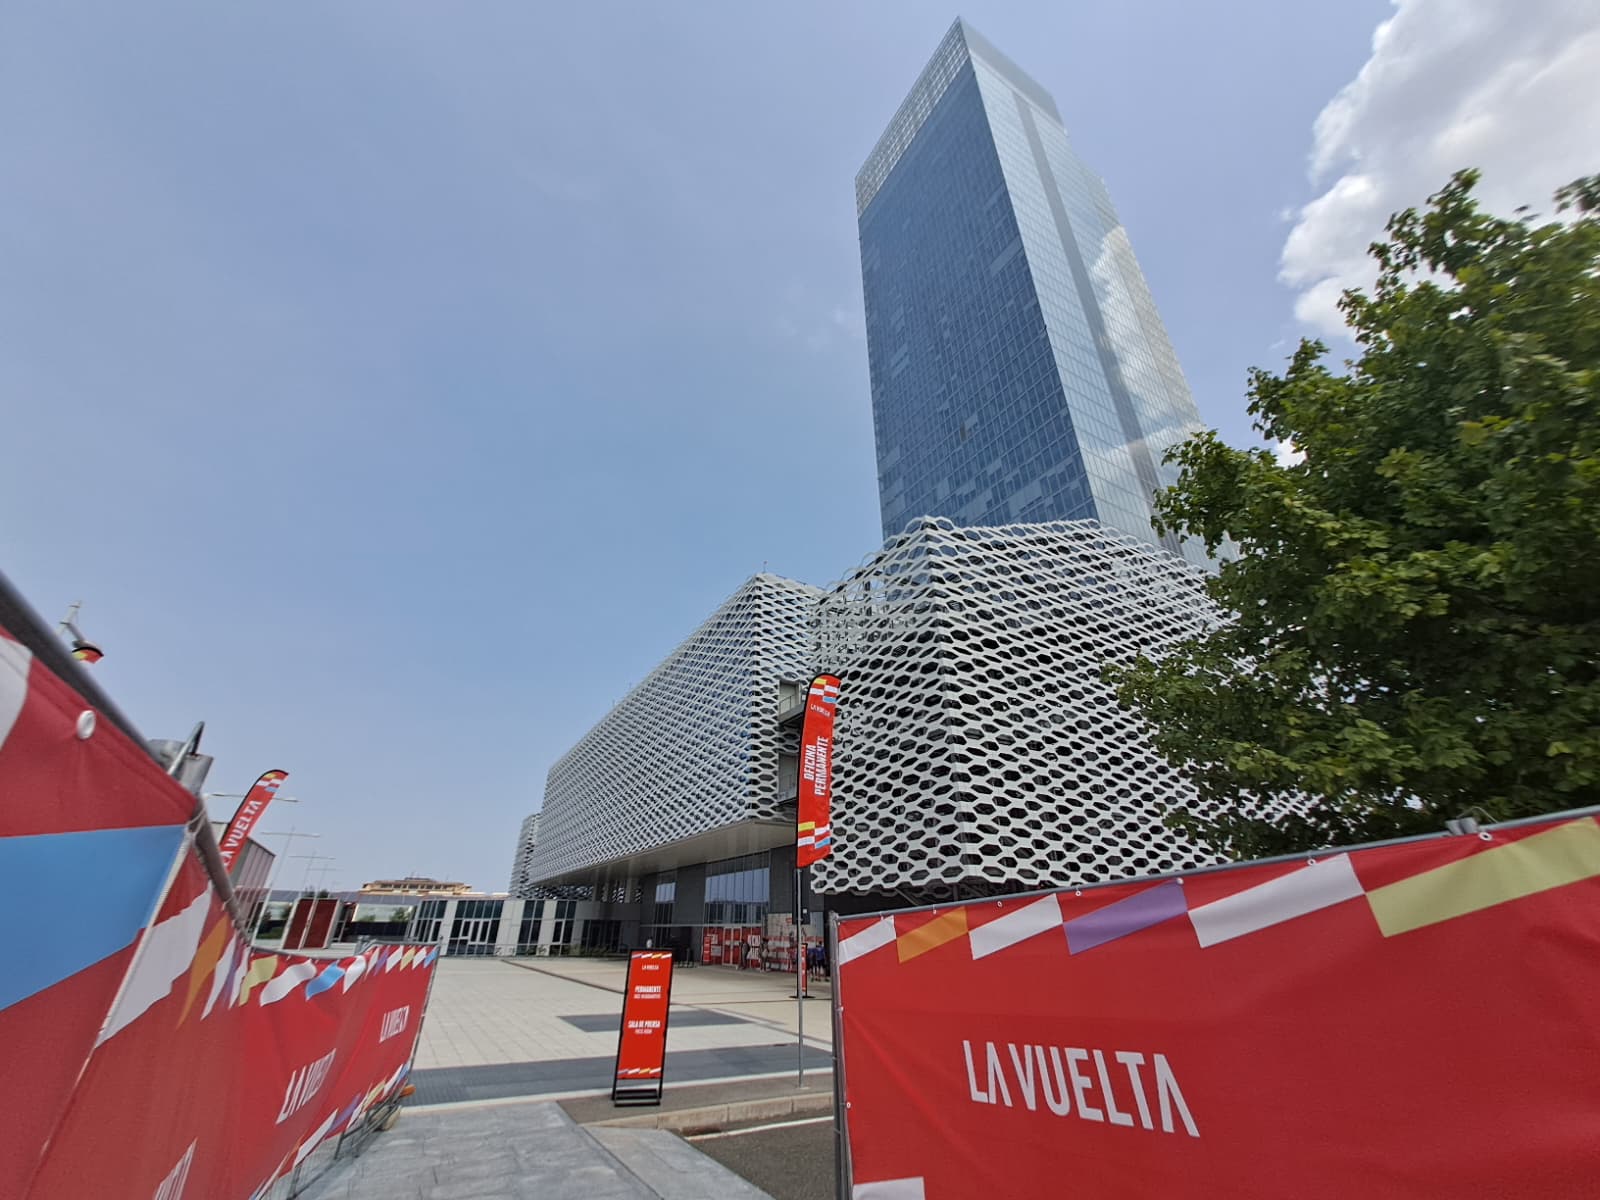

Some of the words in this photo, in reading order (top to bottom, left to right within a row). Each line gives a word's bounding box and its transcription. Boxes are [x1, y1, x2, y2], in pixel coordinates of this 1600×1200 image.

[803, 744, 816, 780] OFICINA
[815, 736, 828, 795] PERMANENTE
[224, 800, 263, 848] VUELTA
[963, 1039, 1013, 1107] LA
[1007, 1042, 1201, 1138] VUELTA
